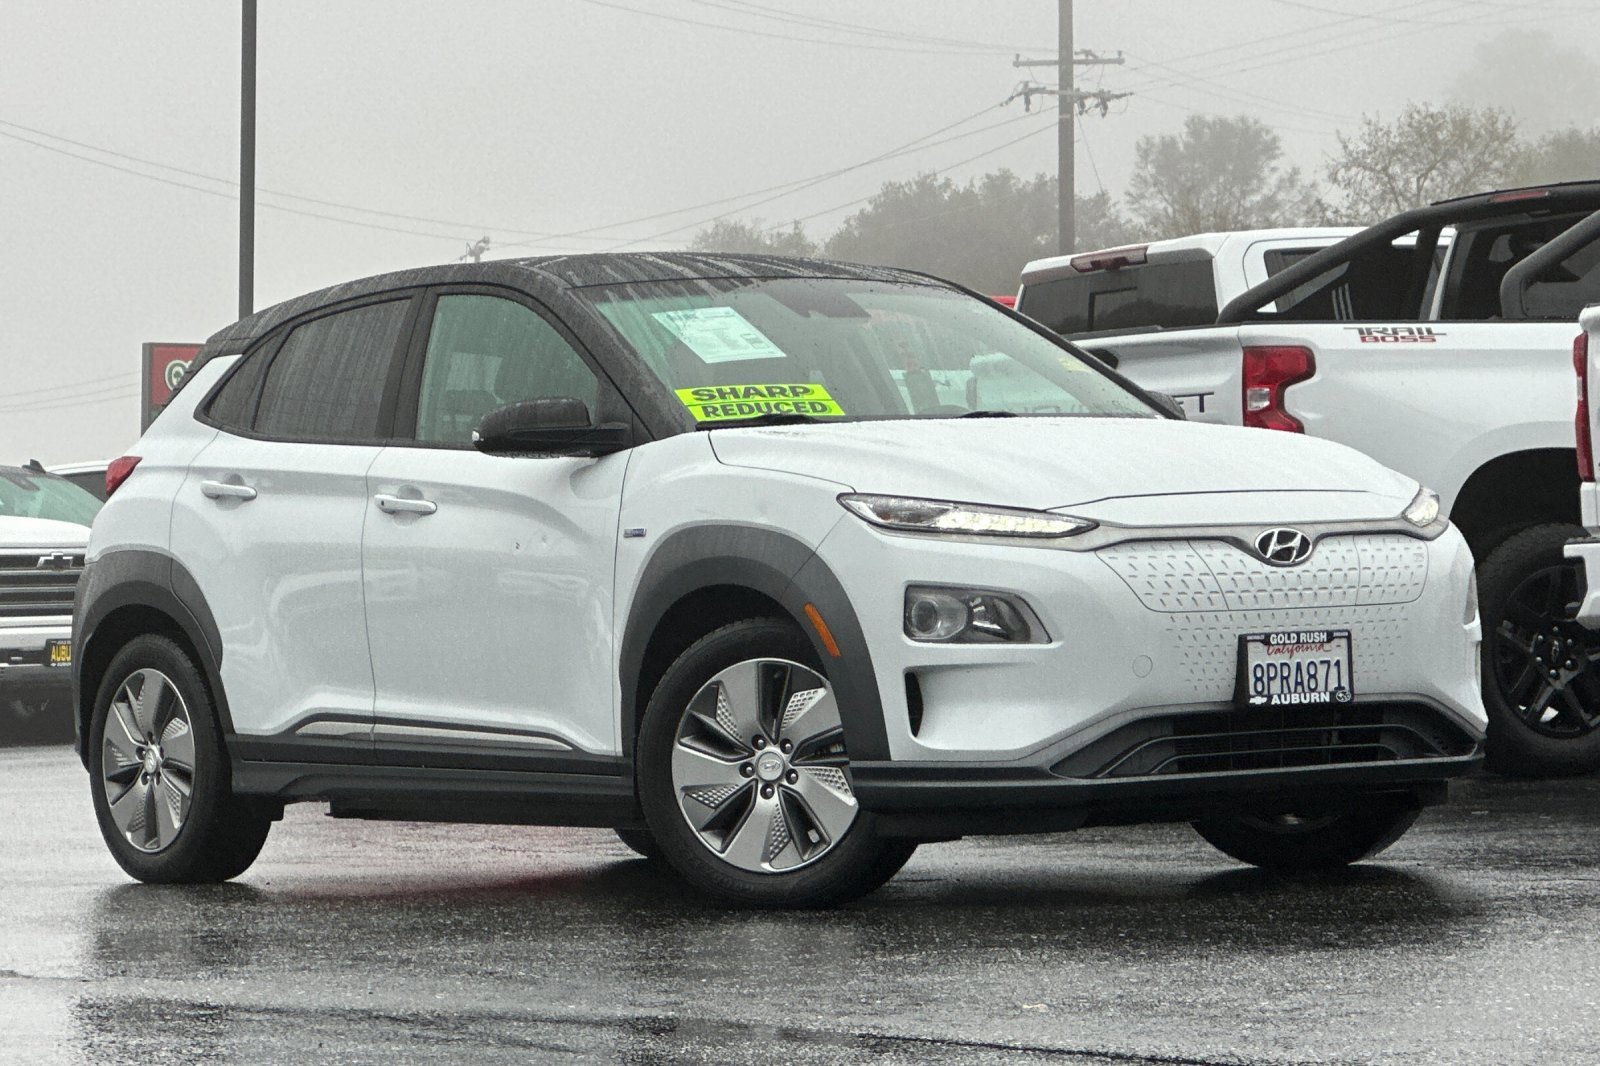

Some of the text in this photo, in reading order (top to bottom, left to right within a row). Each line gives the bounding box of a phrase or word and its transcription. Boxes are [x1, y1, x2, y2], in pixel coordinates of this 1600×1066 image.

[1344, 327, 1447, 335] TRAIL
[690, 385, 815, 402] SHARP
[701, 401, 831, 418] REDUCED
[1269, 634, 1297, 645] GOLD
[1300, 632, 1327, 643] RUSH
[1266, 644, 1332, 659] California
[1253, 660, 1345, 695] 8PRA871
[1271, 692, 1330, 705] AUBURN
